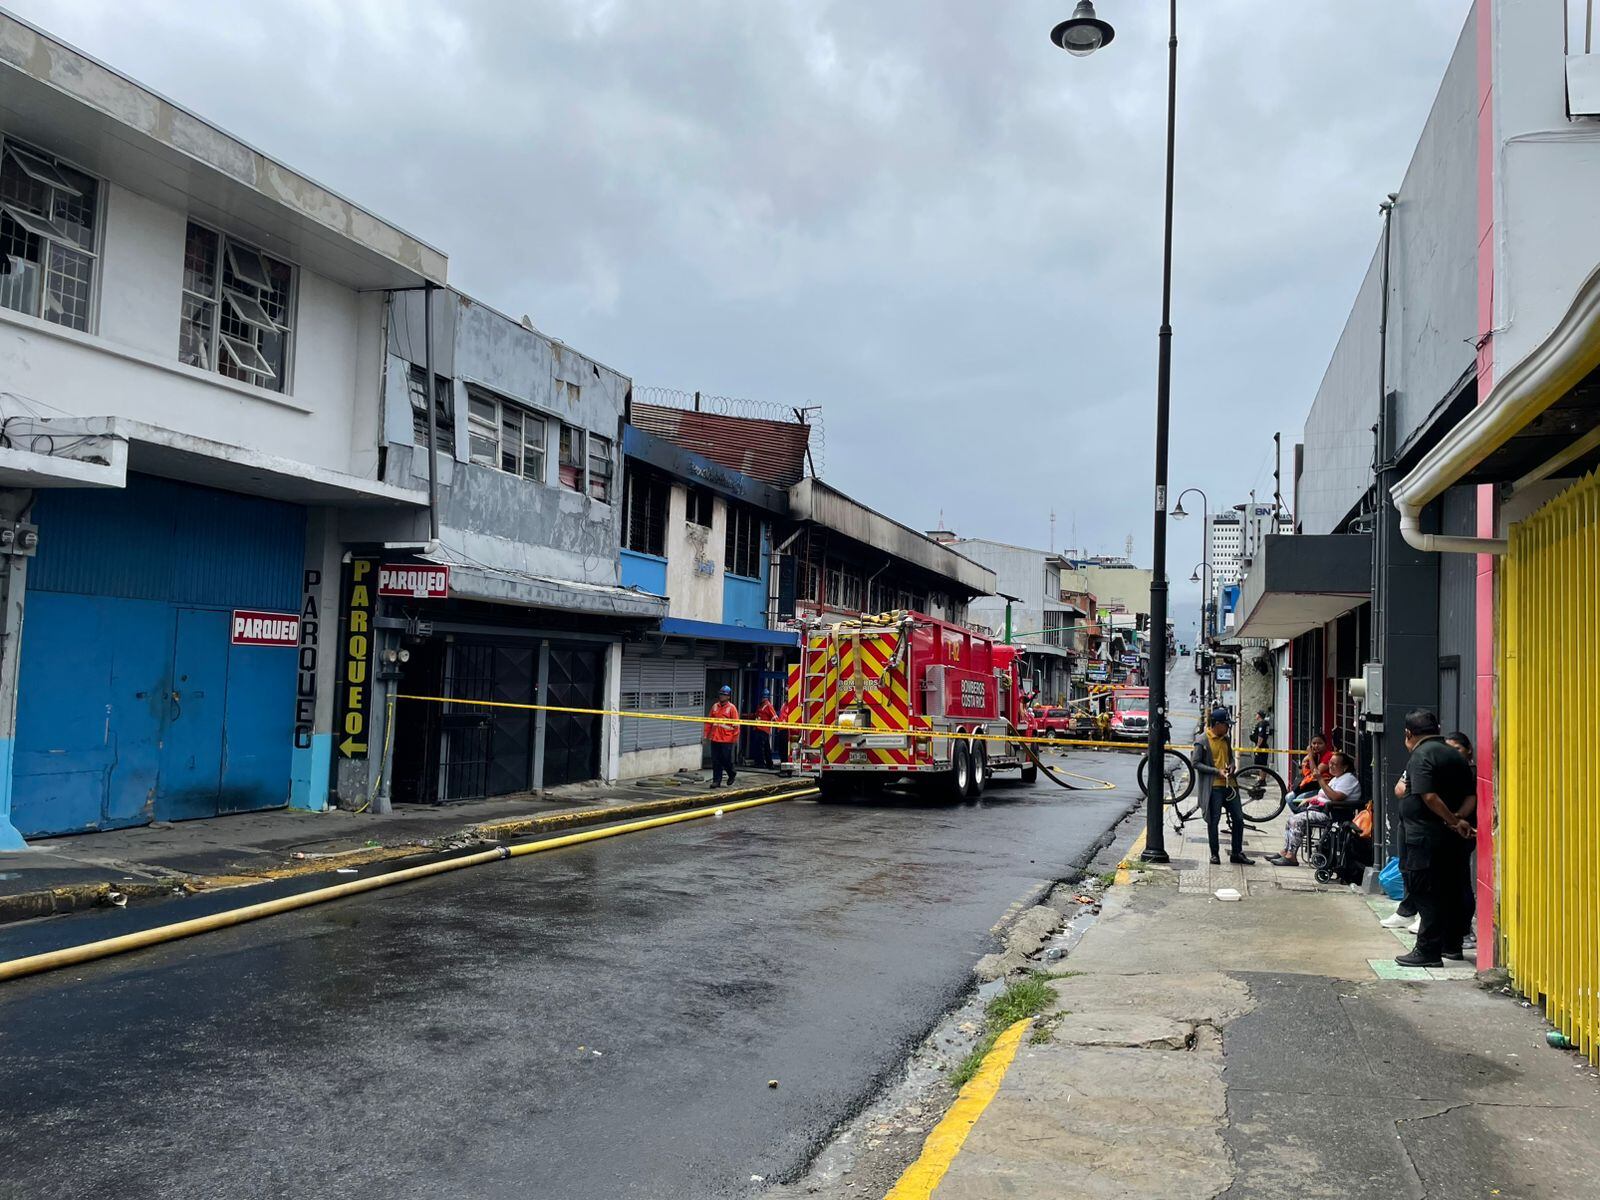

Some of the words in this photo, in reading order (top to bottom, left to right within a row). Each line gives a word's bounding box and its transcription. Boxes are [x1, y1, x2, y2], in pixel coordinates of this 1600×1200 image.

[379, 571, 446, 592] PARQUEO
[234, 617, 298, 640] PARQUEO
[345, 560, 370, 735] PARQUEO
[294, 569, 321, 749] PARQUEO
[961, 679, 985, 695] BOMBEROS
[961, 694, 975, 708] COSTA
[975, 696, 986, 709] RICA
